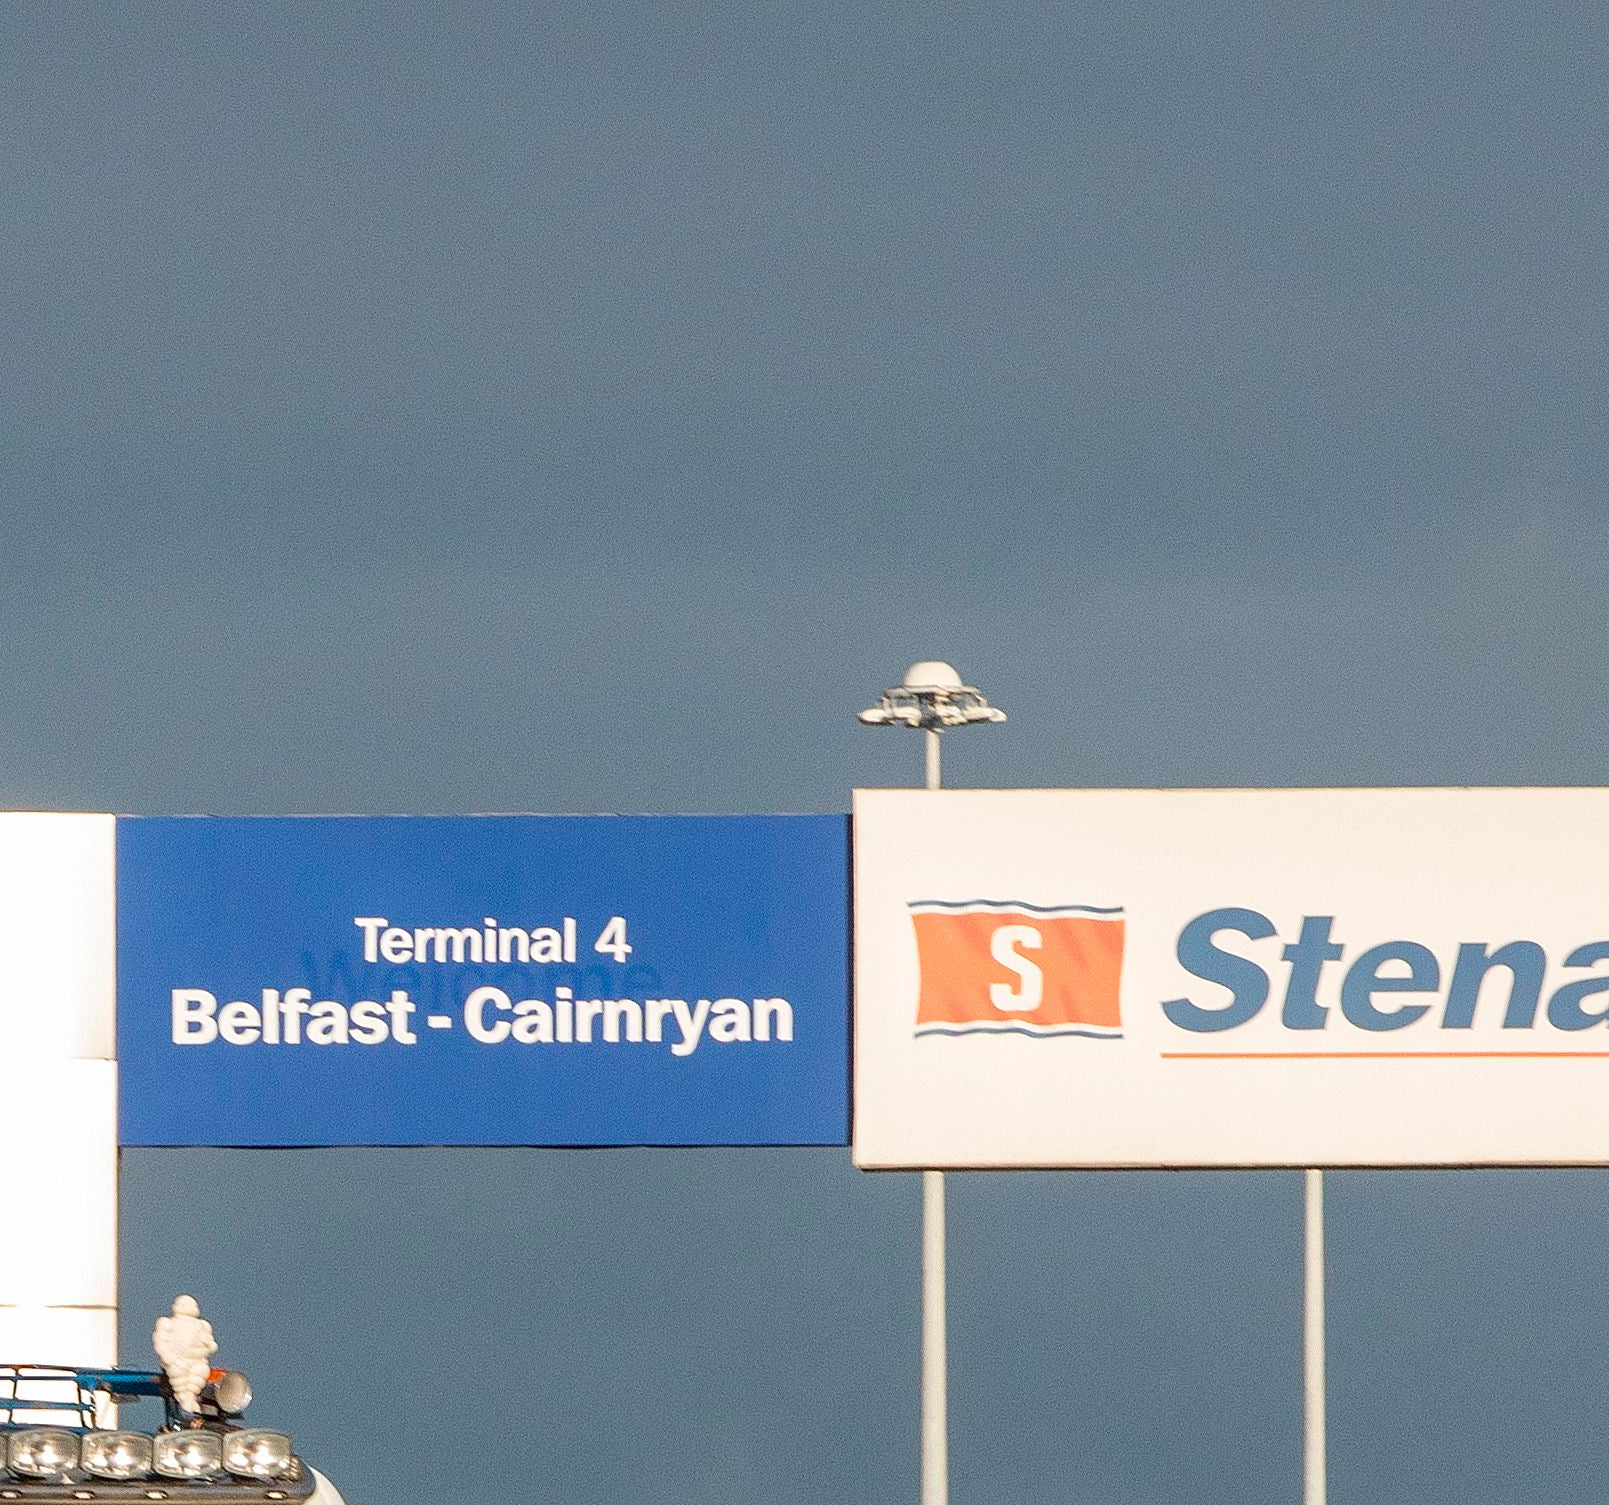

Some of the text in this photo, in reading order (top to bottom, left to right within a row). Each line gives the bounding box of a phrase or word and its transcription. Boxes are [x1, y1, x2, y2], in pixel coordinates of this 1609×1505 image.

[354, 916, 633, 963] Terminal 4
[991, 924, 1045, 1014] S
[170, 988, 418, 1046] Belfast
[463, 985, 794, 1057] Cairnryan
